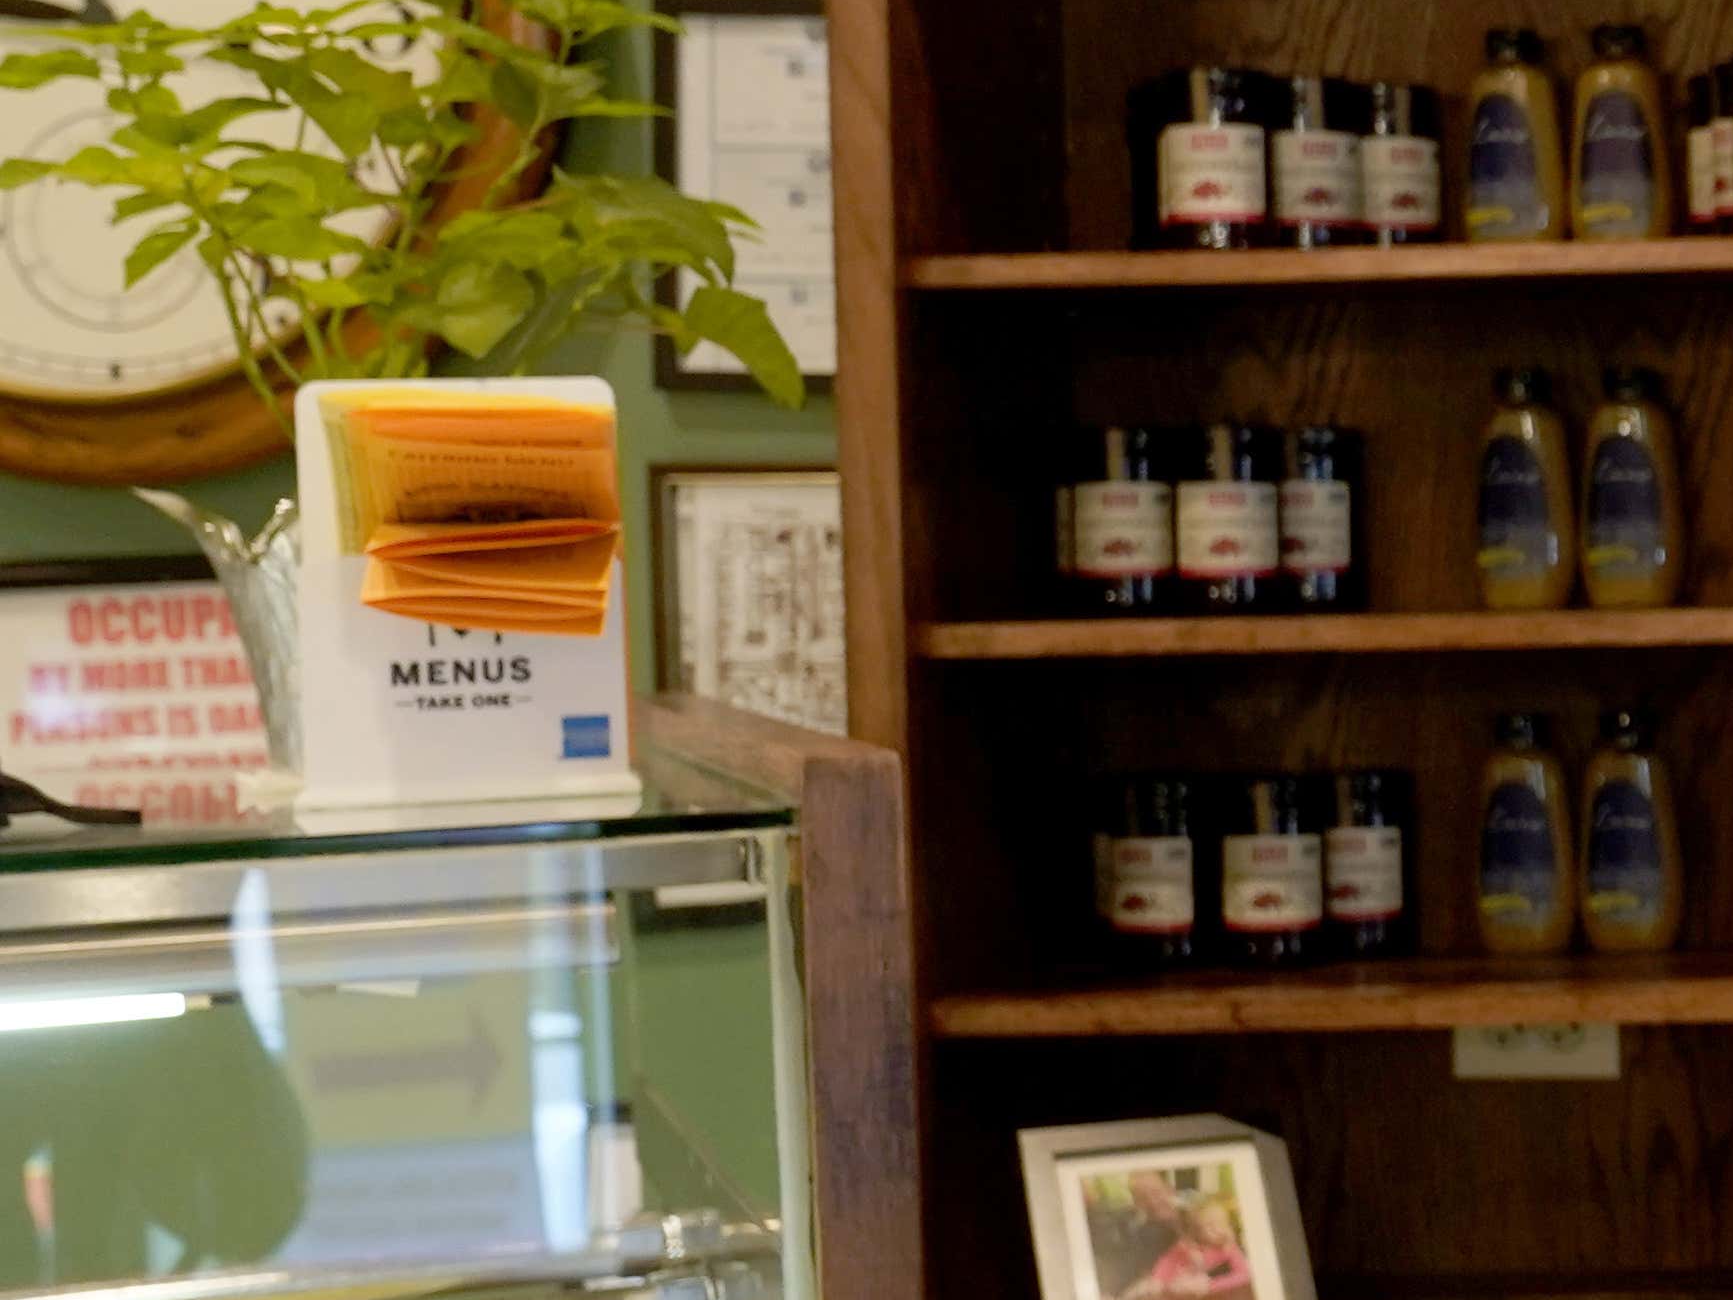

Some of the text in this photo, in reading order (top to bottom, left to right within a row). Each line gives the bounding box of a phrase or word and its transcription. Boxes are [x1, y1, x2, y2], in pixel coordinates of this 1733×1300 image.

[391, 656, 531, 686] MENUS
[416, 694, 510, 710] TAKE ONE
